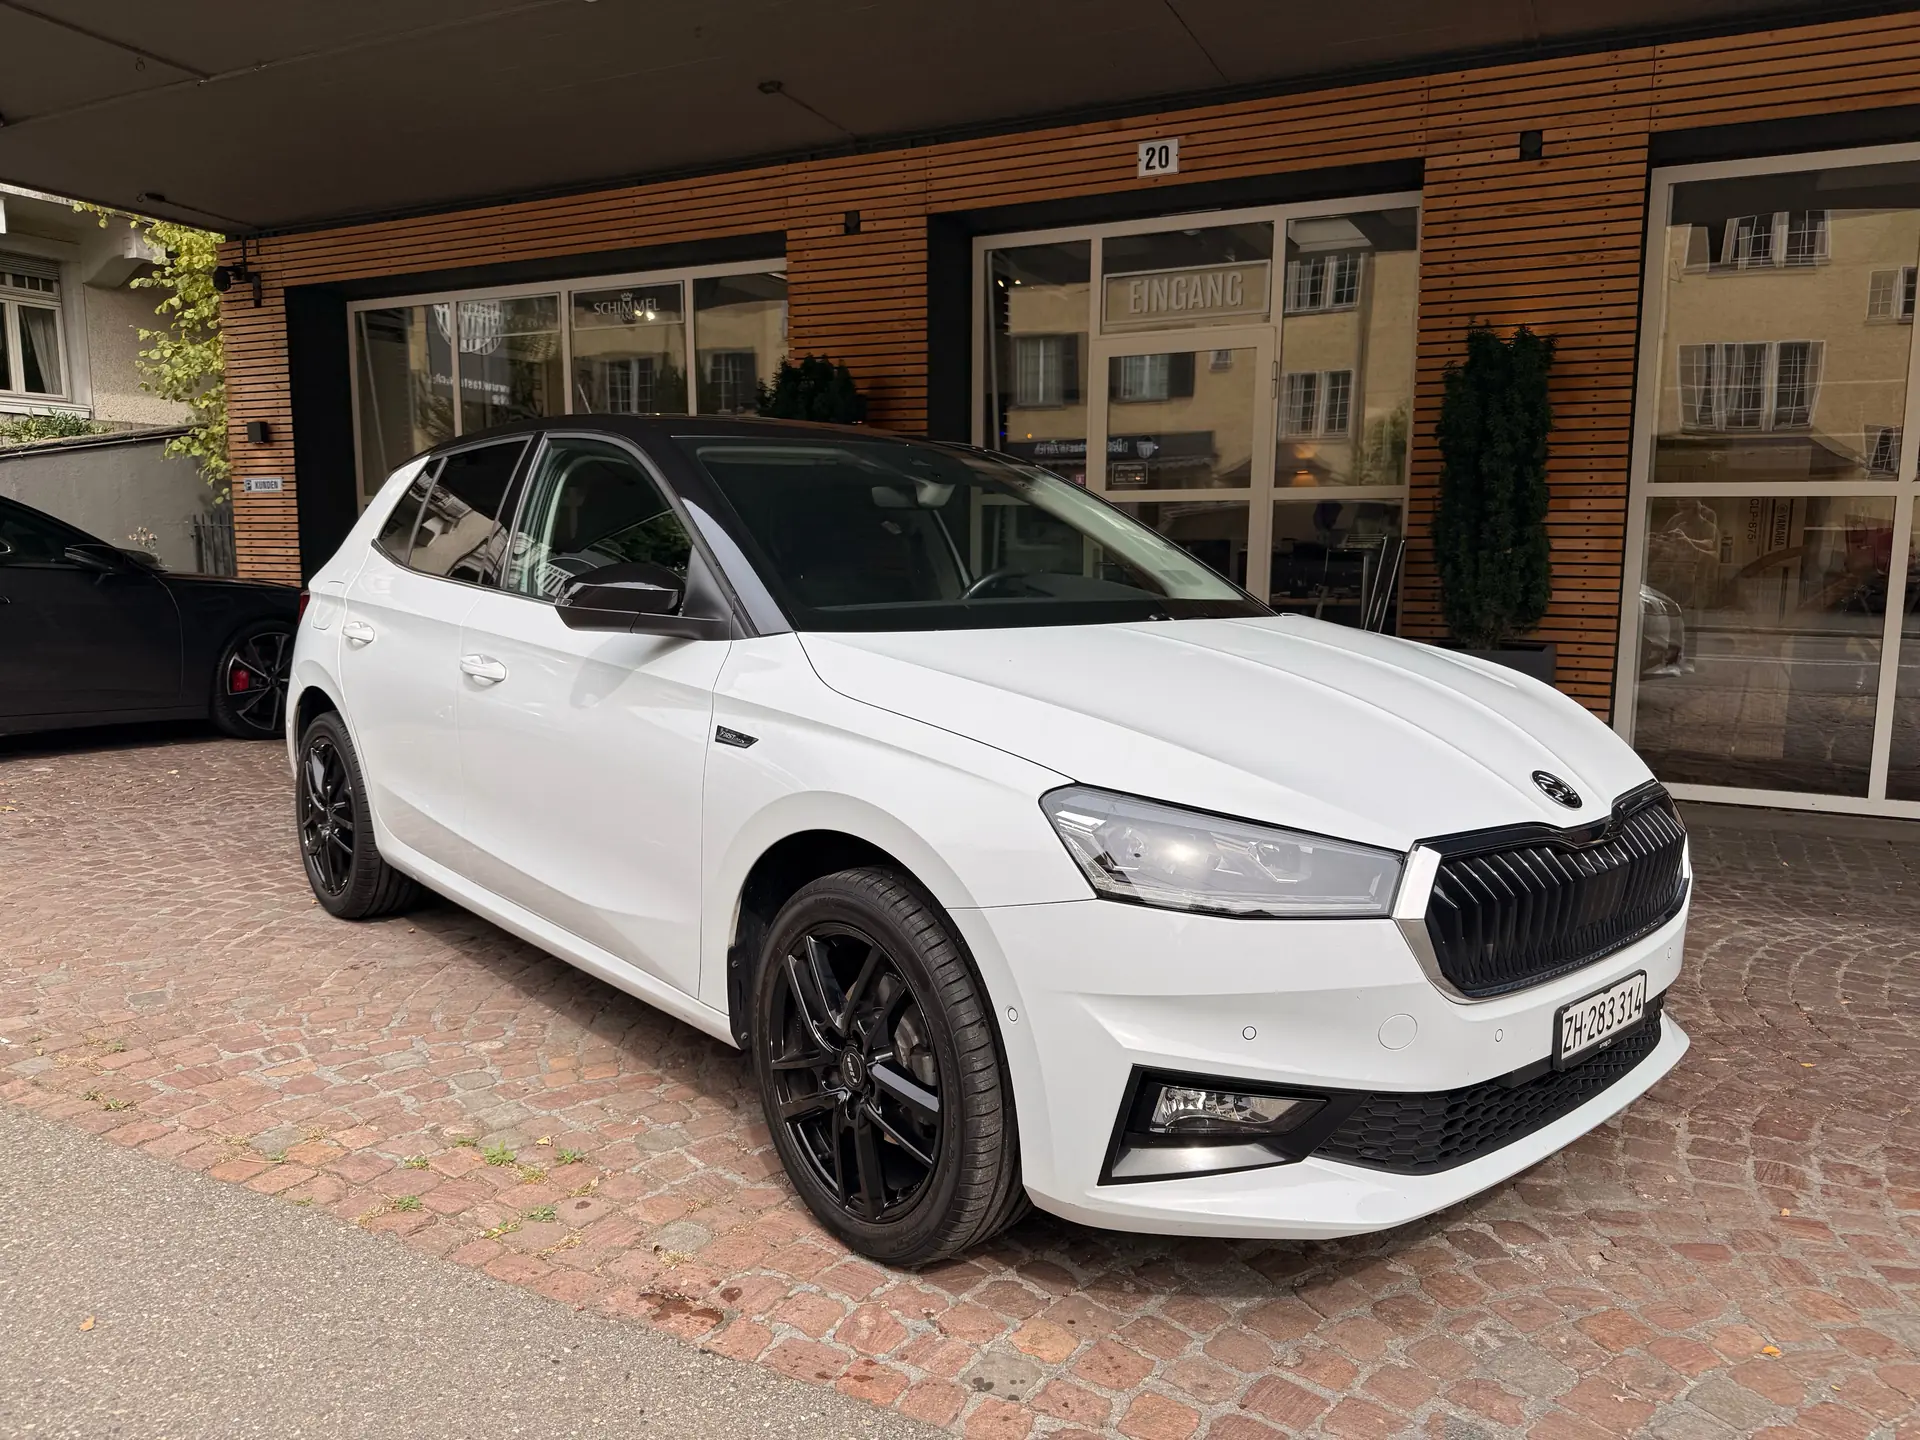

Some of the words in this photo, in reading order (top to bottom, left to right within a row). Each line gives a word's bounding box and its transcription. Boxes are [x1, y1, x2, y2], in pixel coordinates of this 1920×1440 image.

[1145, 145, 1170, 171] 20
[1128, 271, 1244, 315] EINGANG
[592, 298, 661, 316] SCHIMMEL
[255, 480, 279, 490] KUNDEN
[1774, 514, 1786, 546] YAMAHA
